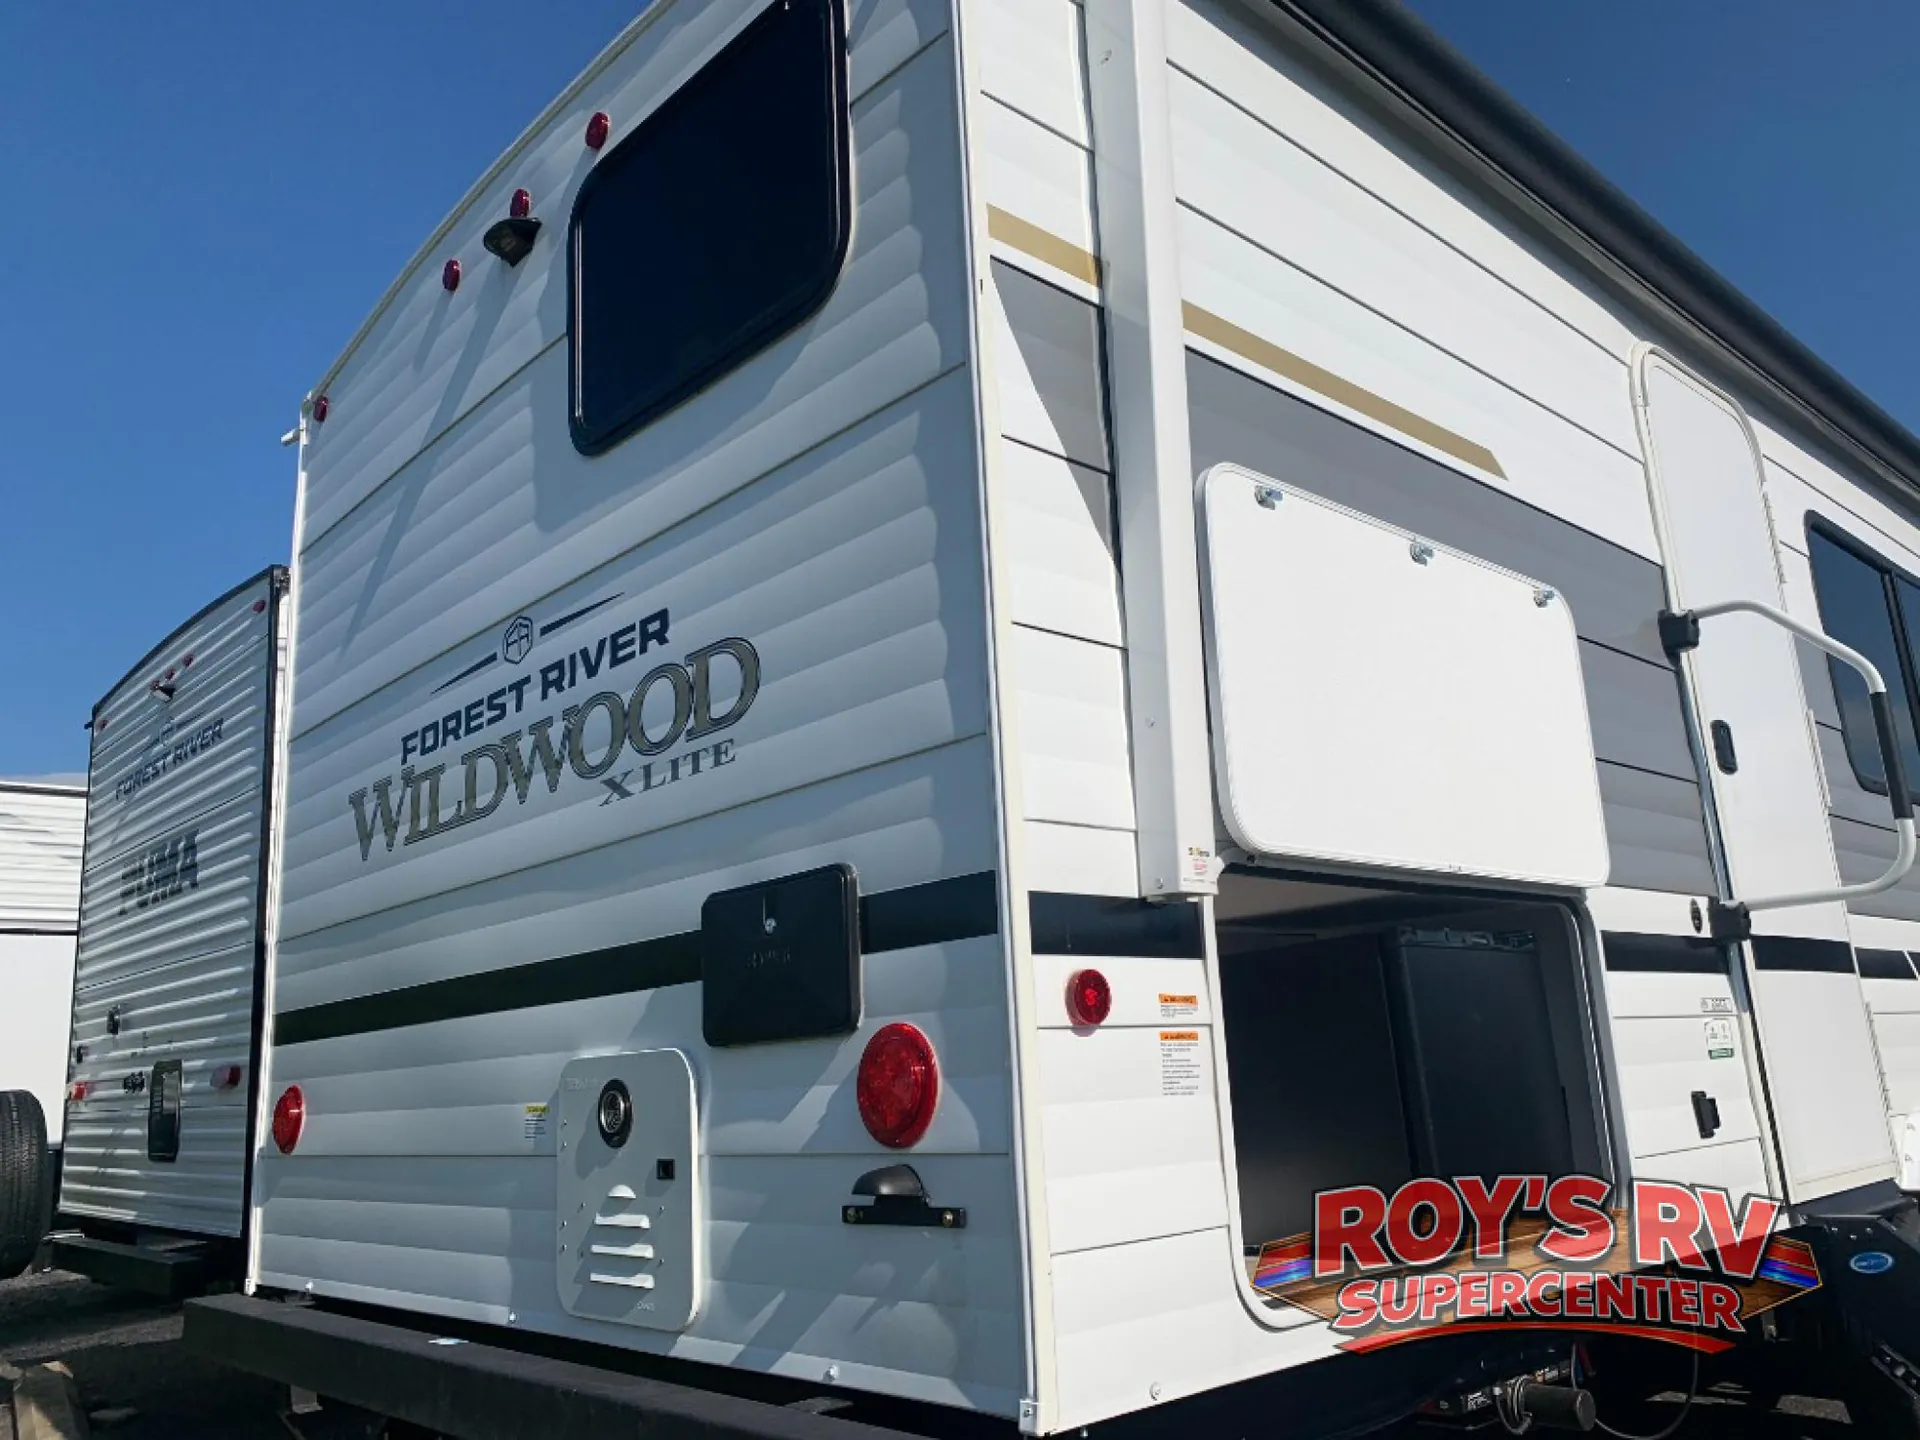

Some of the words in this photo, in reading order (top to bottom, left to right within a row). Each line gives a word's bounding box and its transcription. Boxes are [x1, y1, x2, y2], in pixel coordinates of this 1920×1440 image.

[115, 748, 173, 801] FOREST
[172, 717, 225, 768] RIVER
[348, 636, 761, 862] WILDWOOD
[401, 675, 531, 765] FOREST
[539, 607, 670, 701] RIVER
